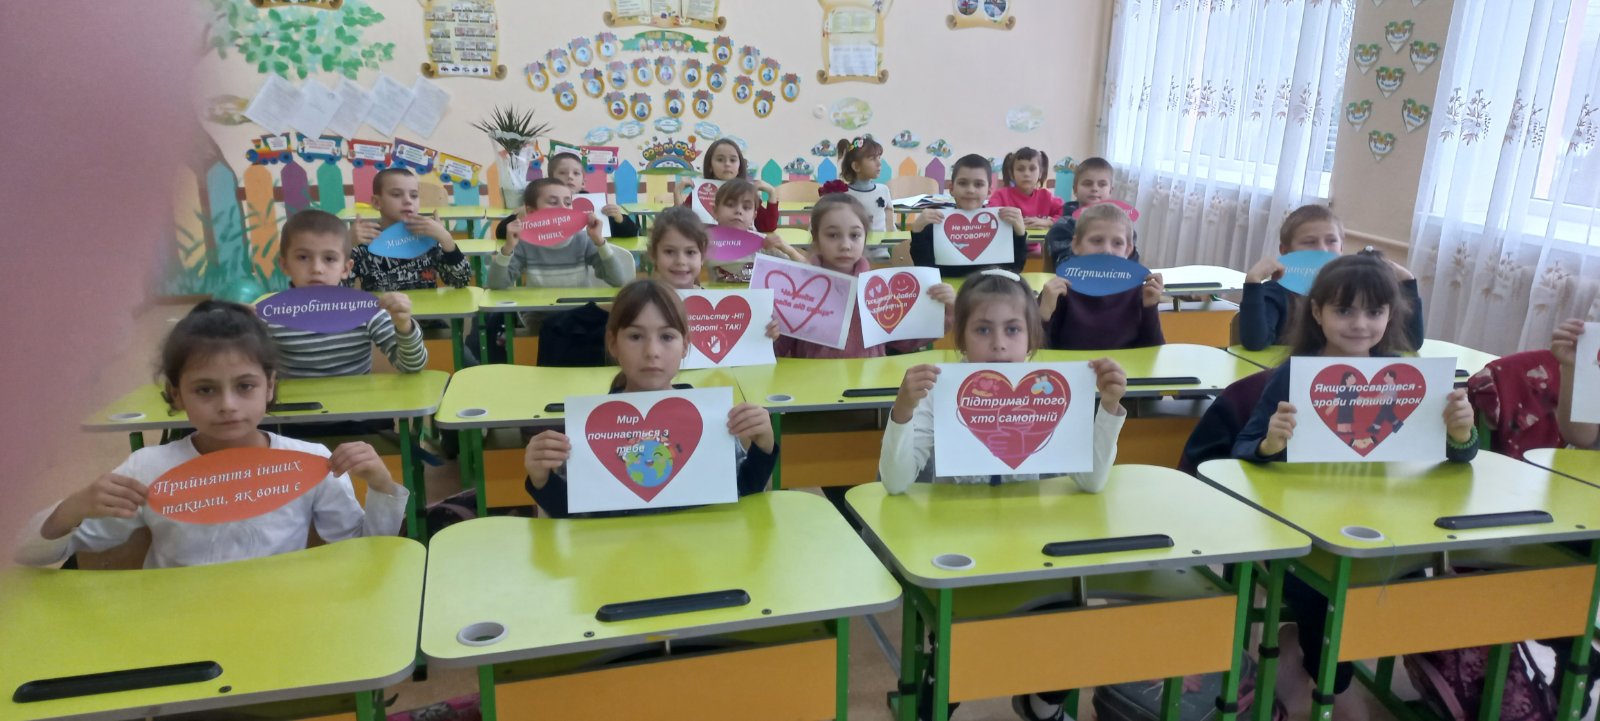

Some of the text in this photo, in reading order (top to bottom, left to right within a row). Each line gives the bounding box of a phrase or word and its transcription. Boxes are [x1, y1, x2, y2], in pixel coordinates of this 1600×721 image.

[1065, 267, 1132, 280] Терпимість
[687, 313, 730, 322] асильству
[724, 323, 742, 331] ТАК!
[1314, 383, 1346, 394] Якщо
[1348, 382, 1415, 393] посварився
[960, 395, 1067, 408] Підтримай того,
[1313, 397, 1347, 408] зроби
[1349, 397, 1393, 407] перший
[616, 415, 639, 425] Мир
[970, 412, 1058, 424] хто самотній
[587, 428, 669, 441] починається з
[616, 443, 645, 454] тебе
[154, 460, 303, 497] Прийняття інших
[234, 490, 257, 503] як
[256, 483, 289, 498] вони
[293, 482, 301, 492] є
